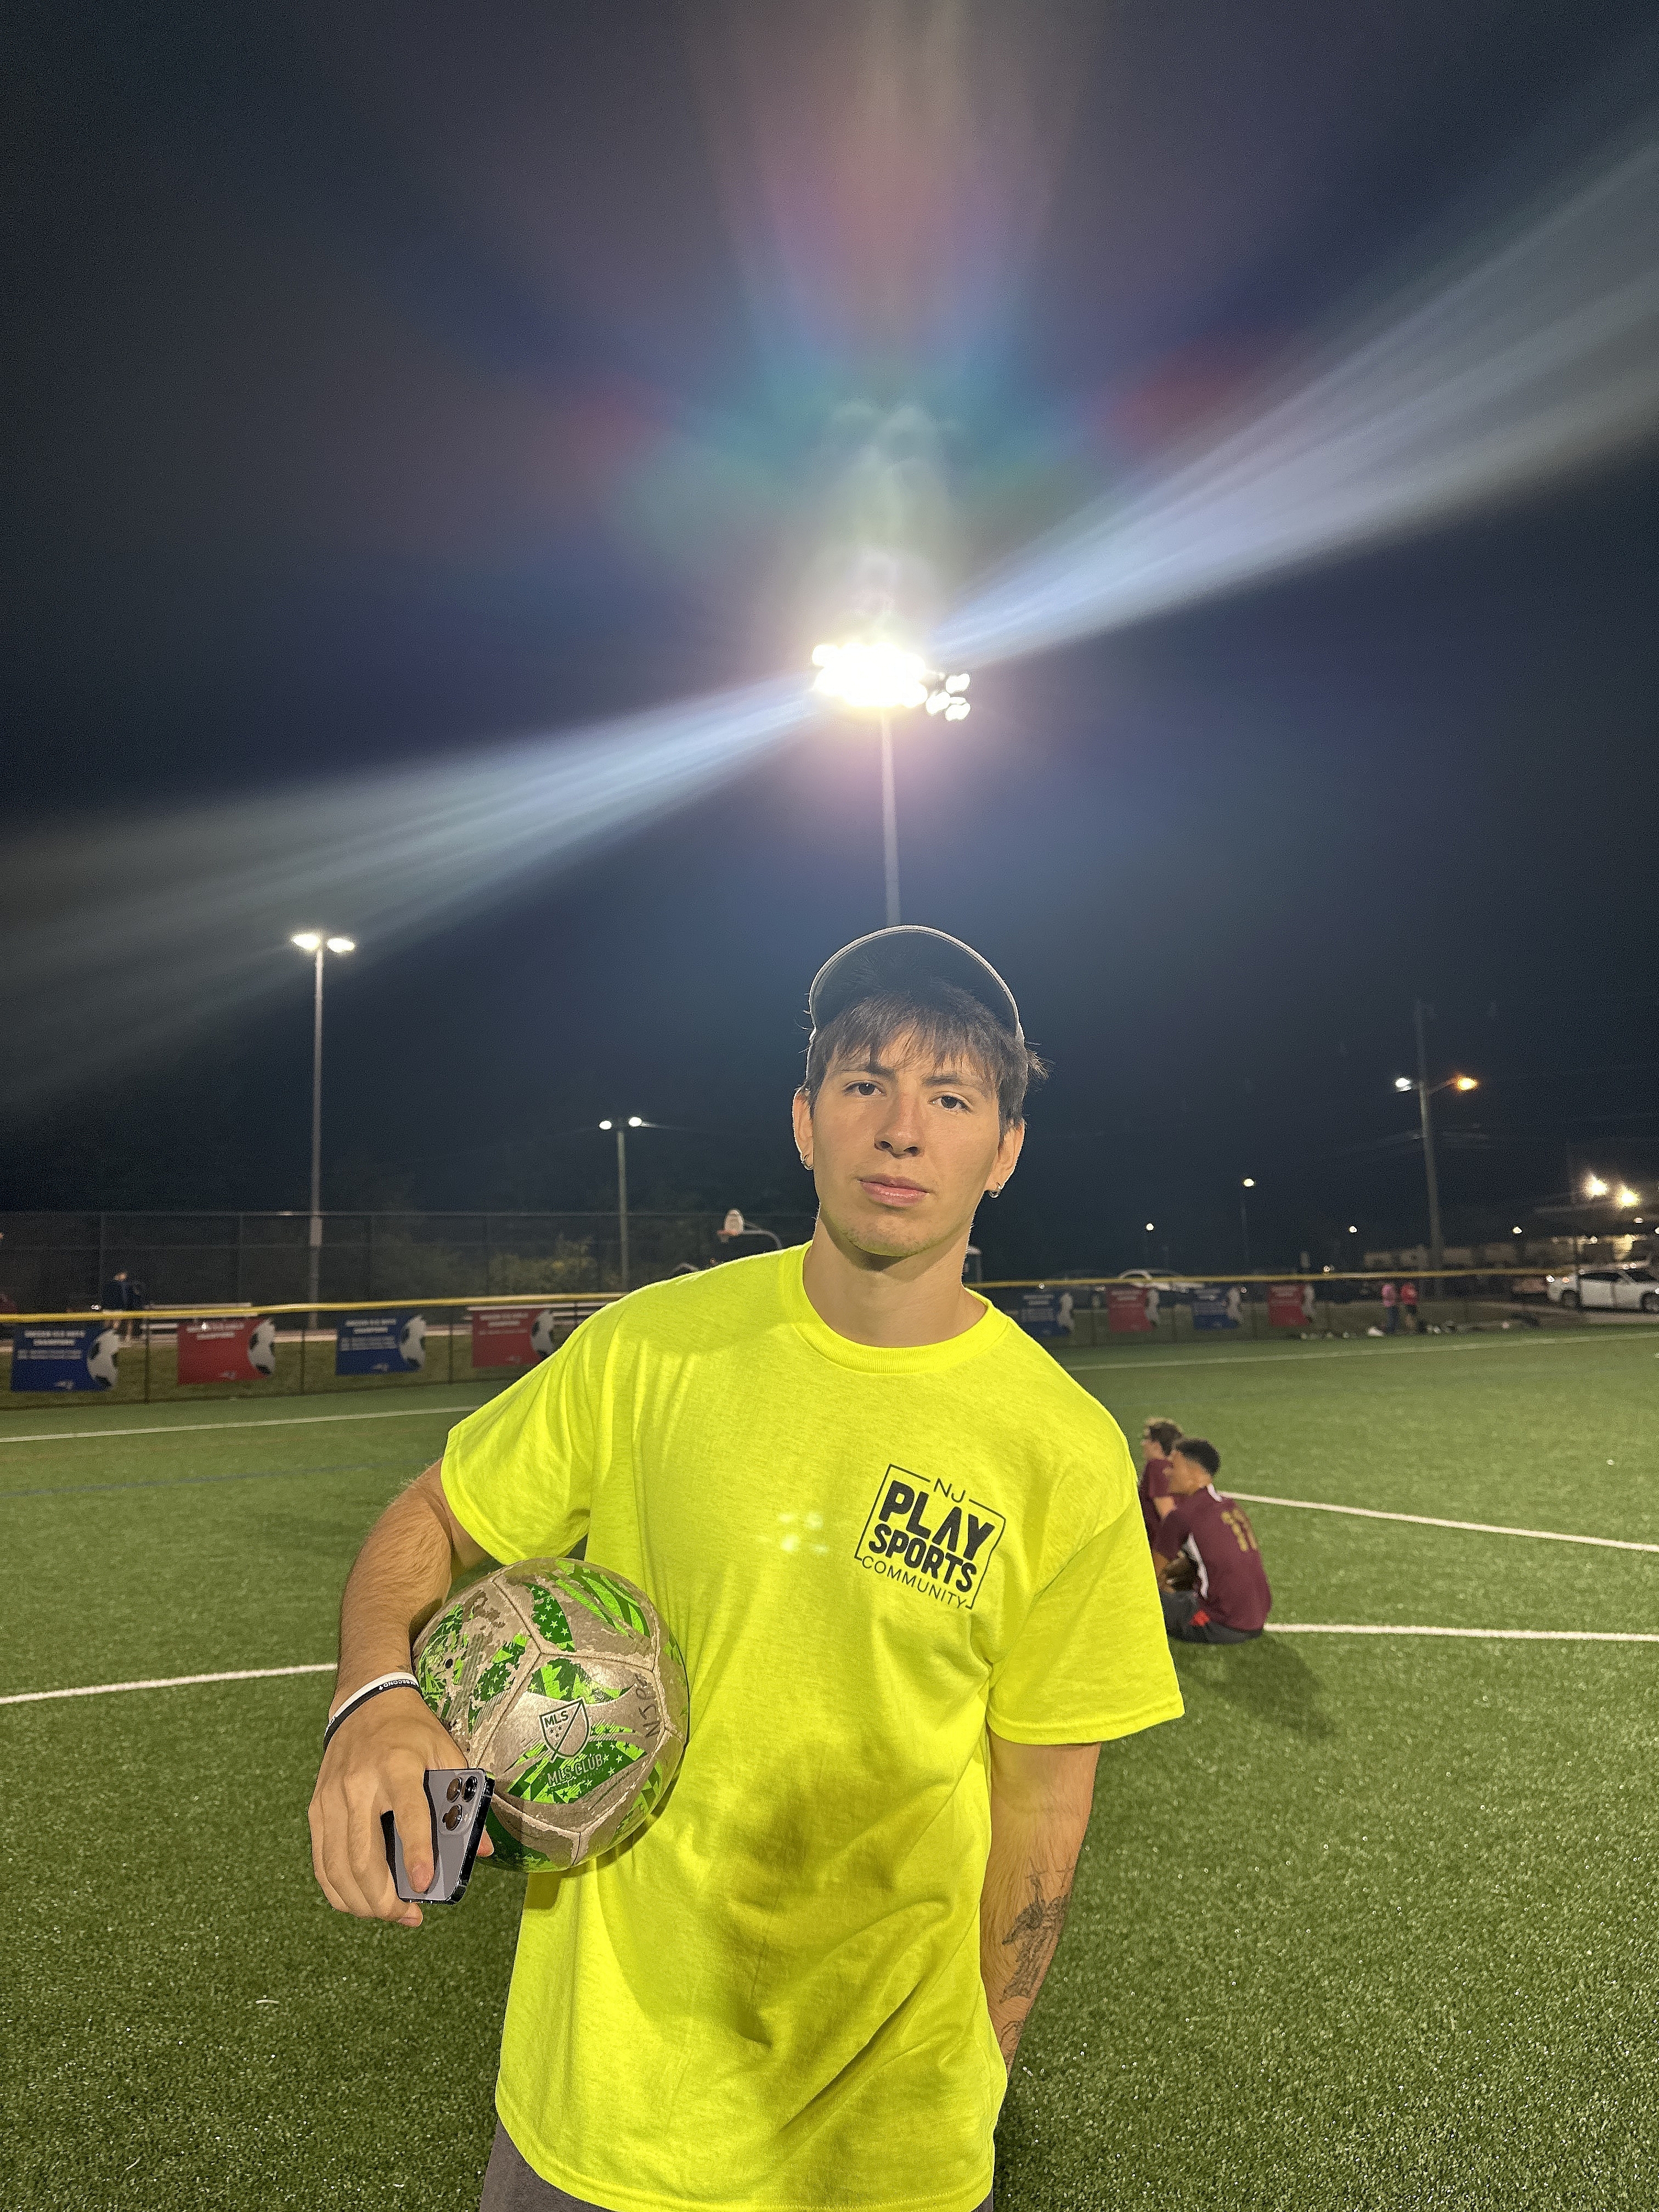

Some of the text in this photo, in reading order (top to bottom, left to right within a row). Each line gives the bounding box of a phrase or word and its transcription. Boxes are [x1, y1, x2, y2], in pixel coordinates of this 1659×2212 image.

[933, 1477, 966, 1503] NJ
[878, 1480, 995, 1561] PLAY
[868, 1523, 977, 1593] SPORTS
[862, 1555, 967, 1609] COMMUNITY
[544, 1711, 569, 1728] MLS
[547, 1766, 572, 1785] MLS
[574, 1753, 603, 1776] CLUB
